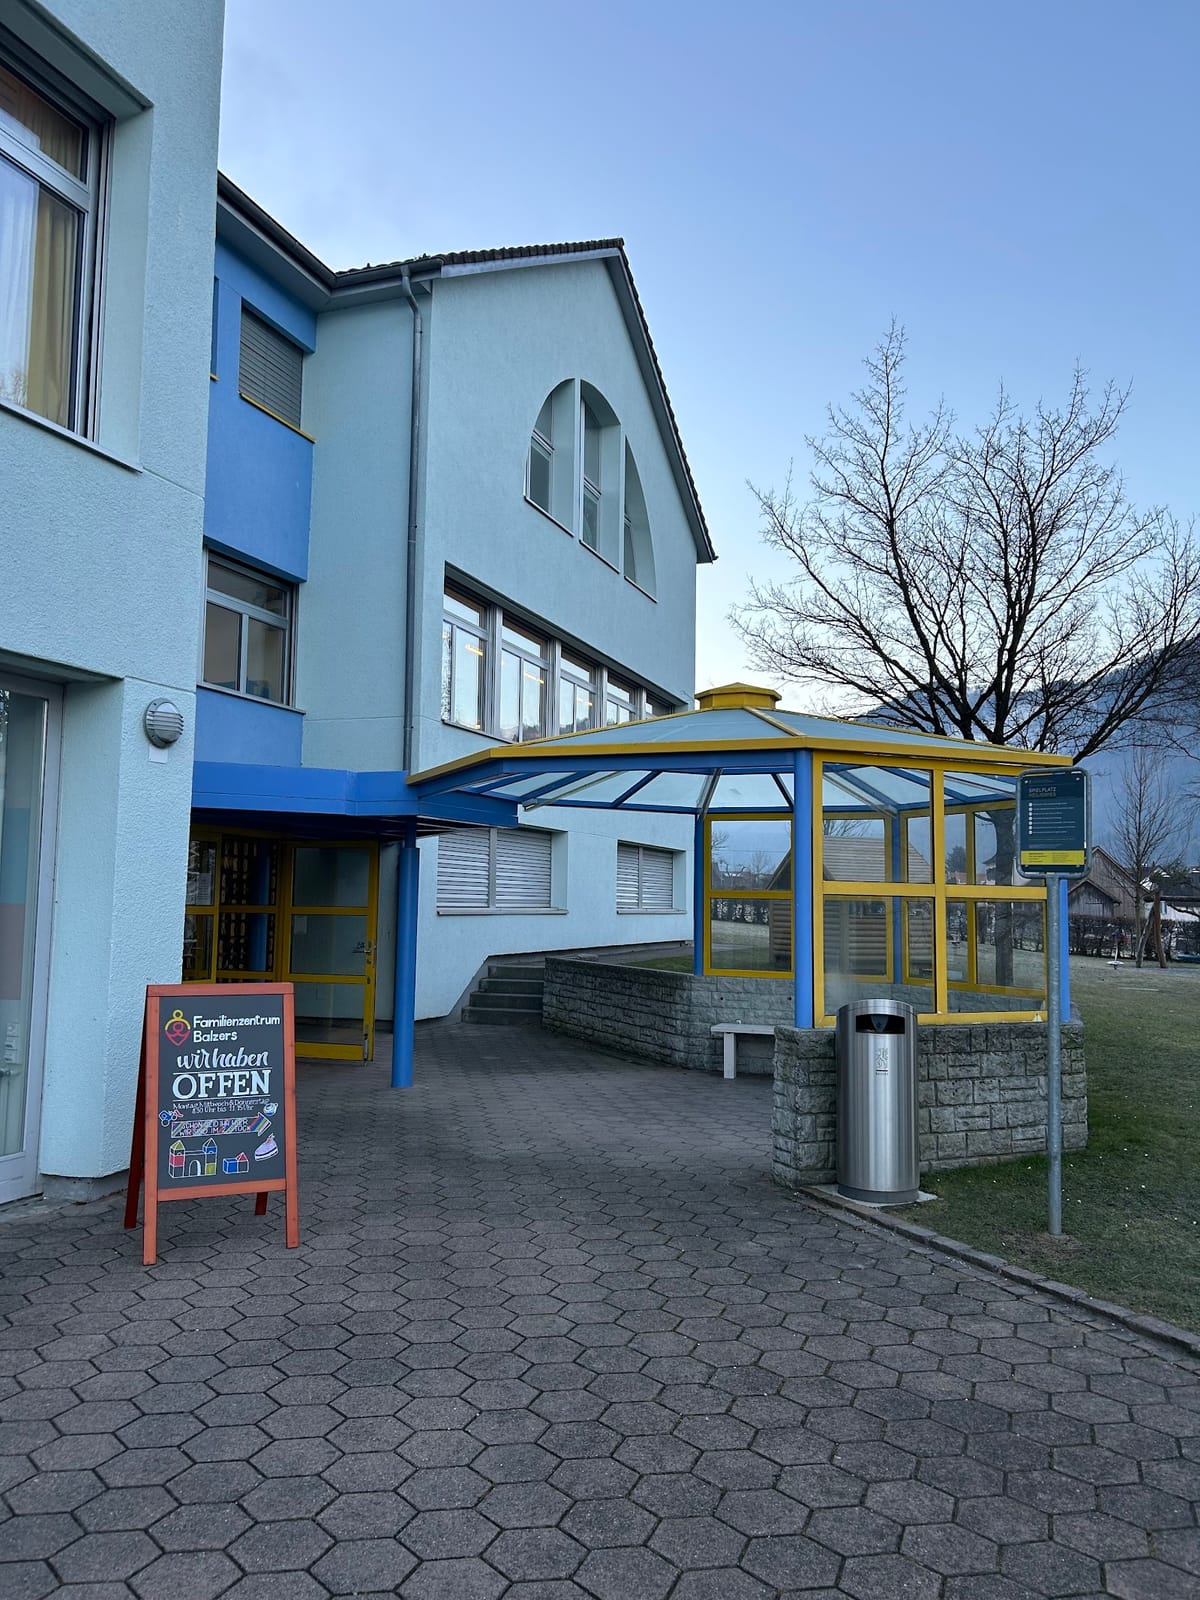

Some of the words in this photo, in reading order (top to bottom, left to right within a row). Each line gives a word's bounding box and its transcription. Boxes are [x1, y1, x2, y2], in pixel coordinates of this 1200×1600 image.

[193, 1014, 281, 1028] Familienzentrum
[193, 1030, 238, 1043] Balzers
[177, 1048, 211, 1069] wir
[212, 1047, 269, 1068] haben
[172, 1069, 271, 1099] OFFEN
